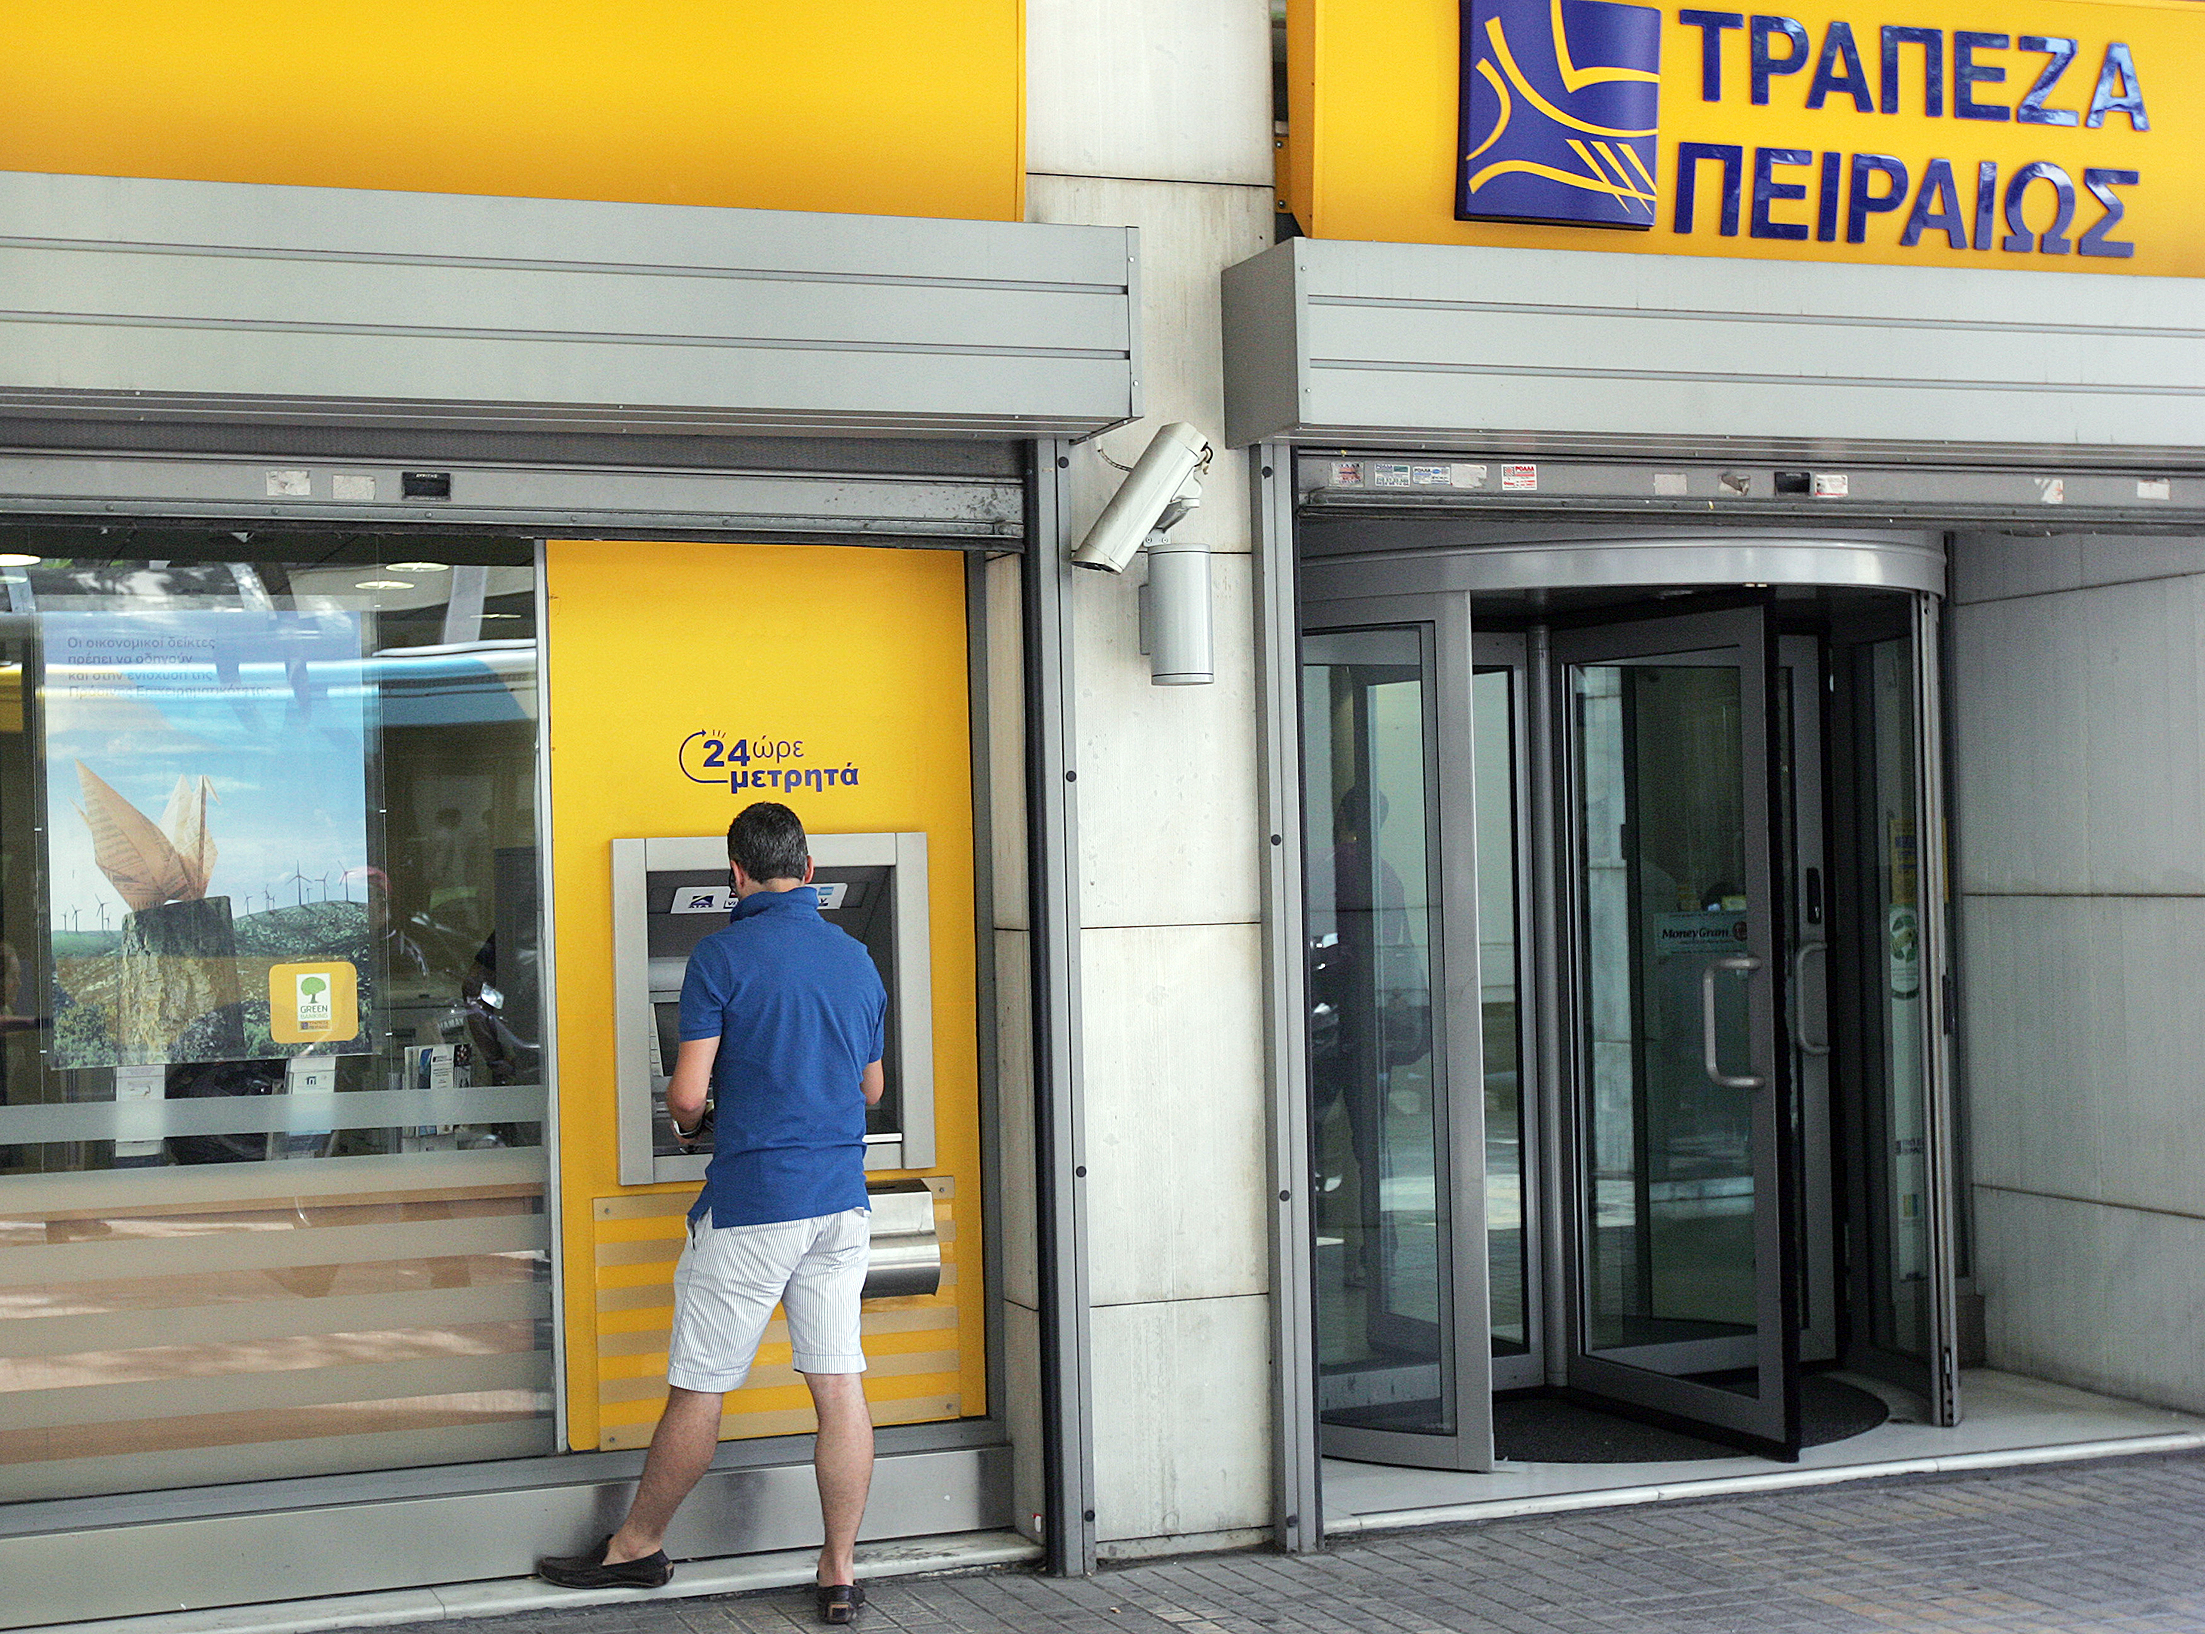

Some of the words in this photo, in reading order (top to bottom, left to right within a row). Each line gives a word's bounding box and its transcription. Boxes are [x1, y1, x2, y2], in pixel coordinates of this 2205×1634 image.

[1679, 9, 2151, 132] ΤΡΑΠΕΖΑ
[1674, 141, 2141, 259] ΠΕΙΡΑΙΩΣ
[67, 637, 82, 649] Οι
[86, 636, 164, 650] οικονομικοί
[167, 636, 216, 650] δείκτες
[68, 653, 112, 665] πρέπει
[116, 655, 133, 664] να
[135, 653, 193, 666] οδηγούν
[68, 671, 89, 681] και
[92, 671, 123, 682] στην
[191, 671, 213, 682] της
[730, 762, 860, 795] μετρητά
[300, 1004, 328, 1013] GREEN
